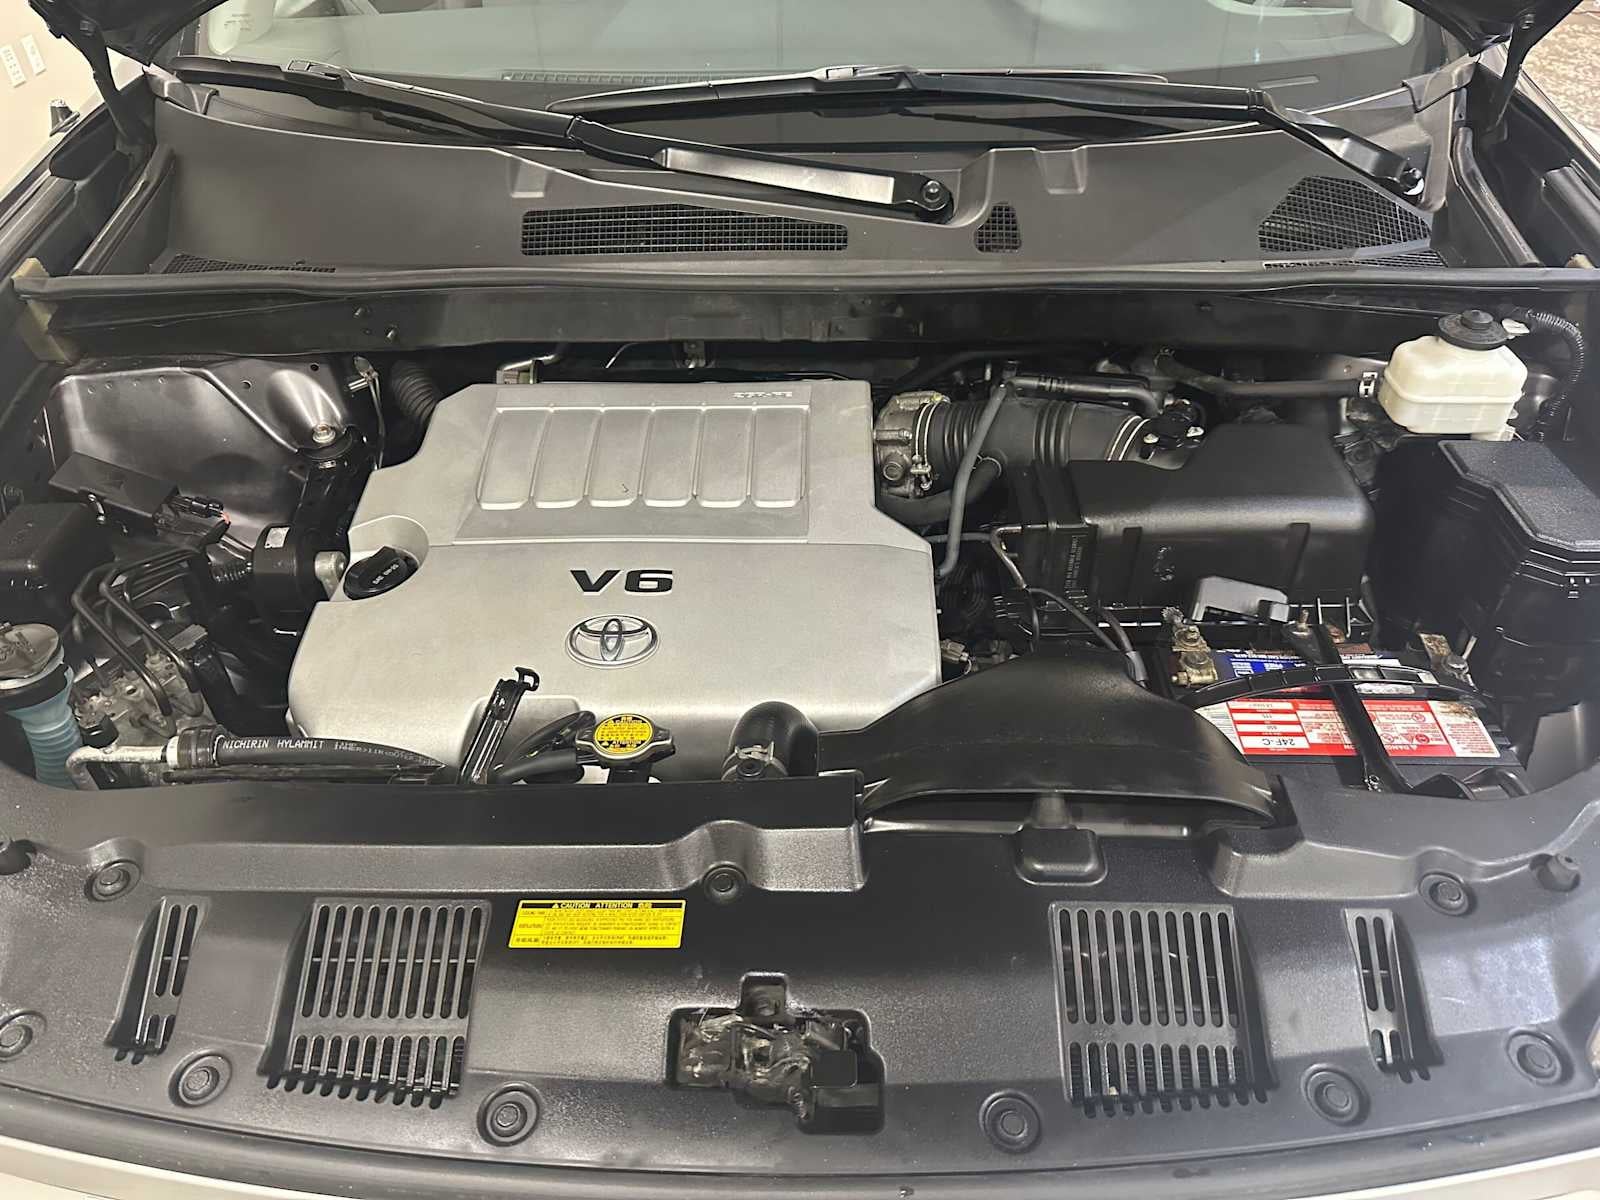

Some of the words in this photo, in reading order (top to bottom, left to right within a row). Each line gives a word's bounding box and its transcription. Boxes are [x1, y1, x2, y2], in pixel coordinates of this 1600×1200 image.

[570, 569, 673, 592] V6
[222, 740, 269, 749] NICHIRIN
[277, 740, 324, 749] HYLAMMIT
[1262, 738, 1296, 746] 24F-C
